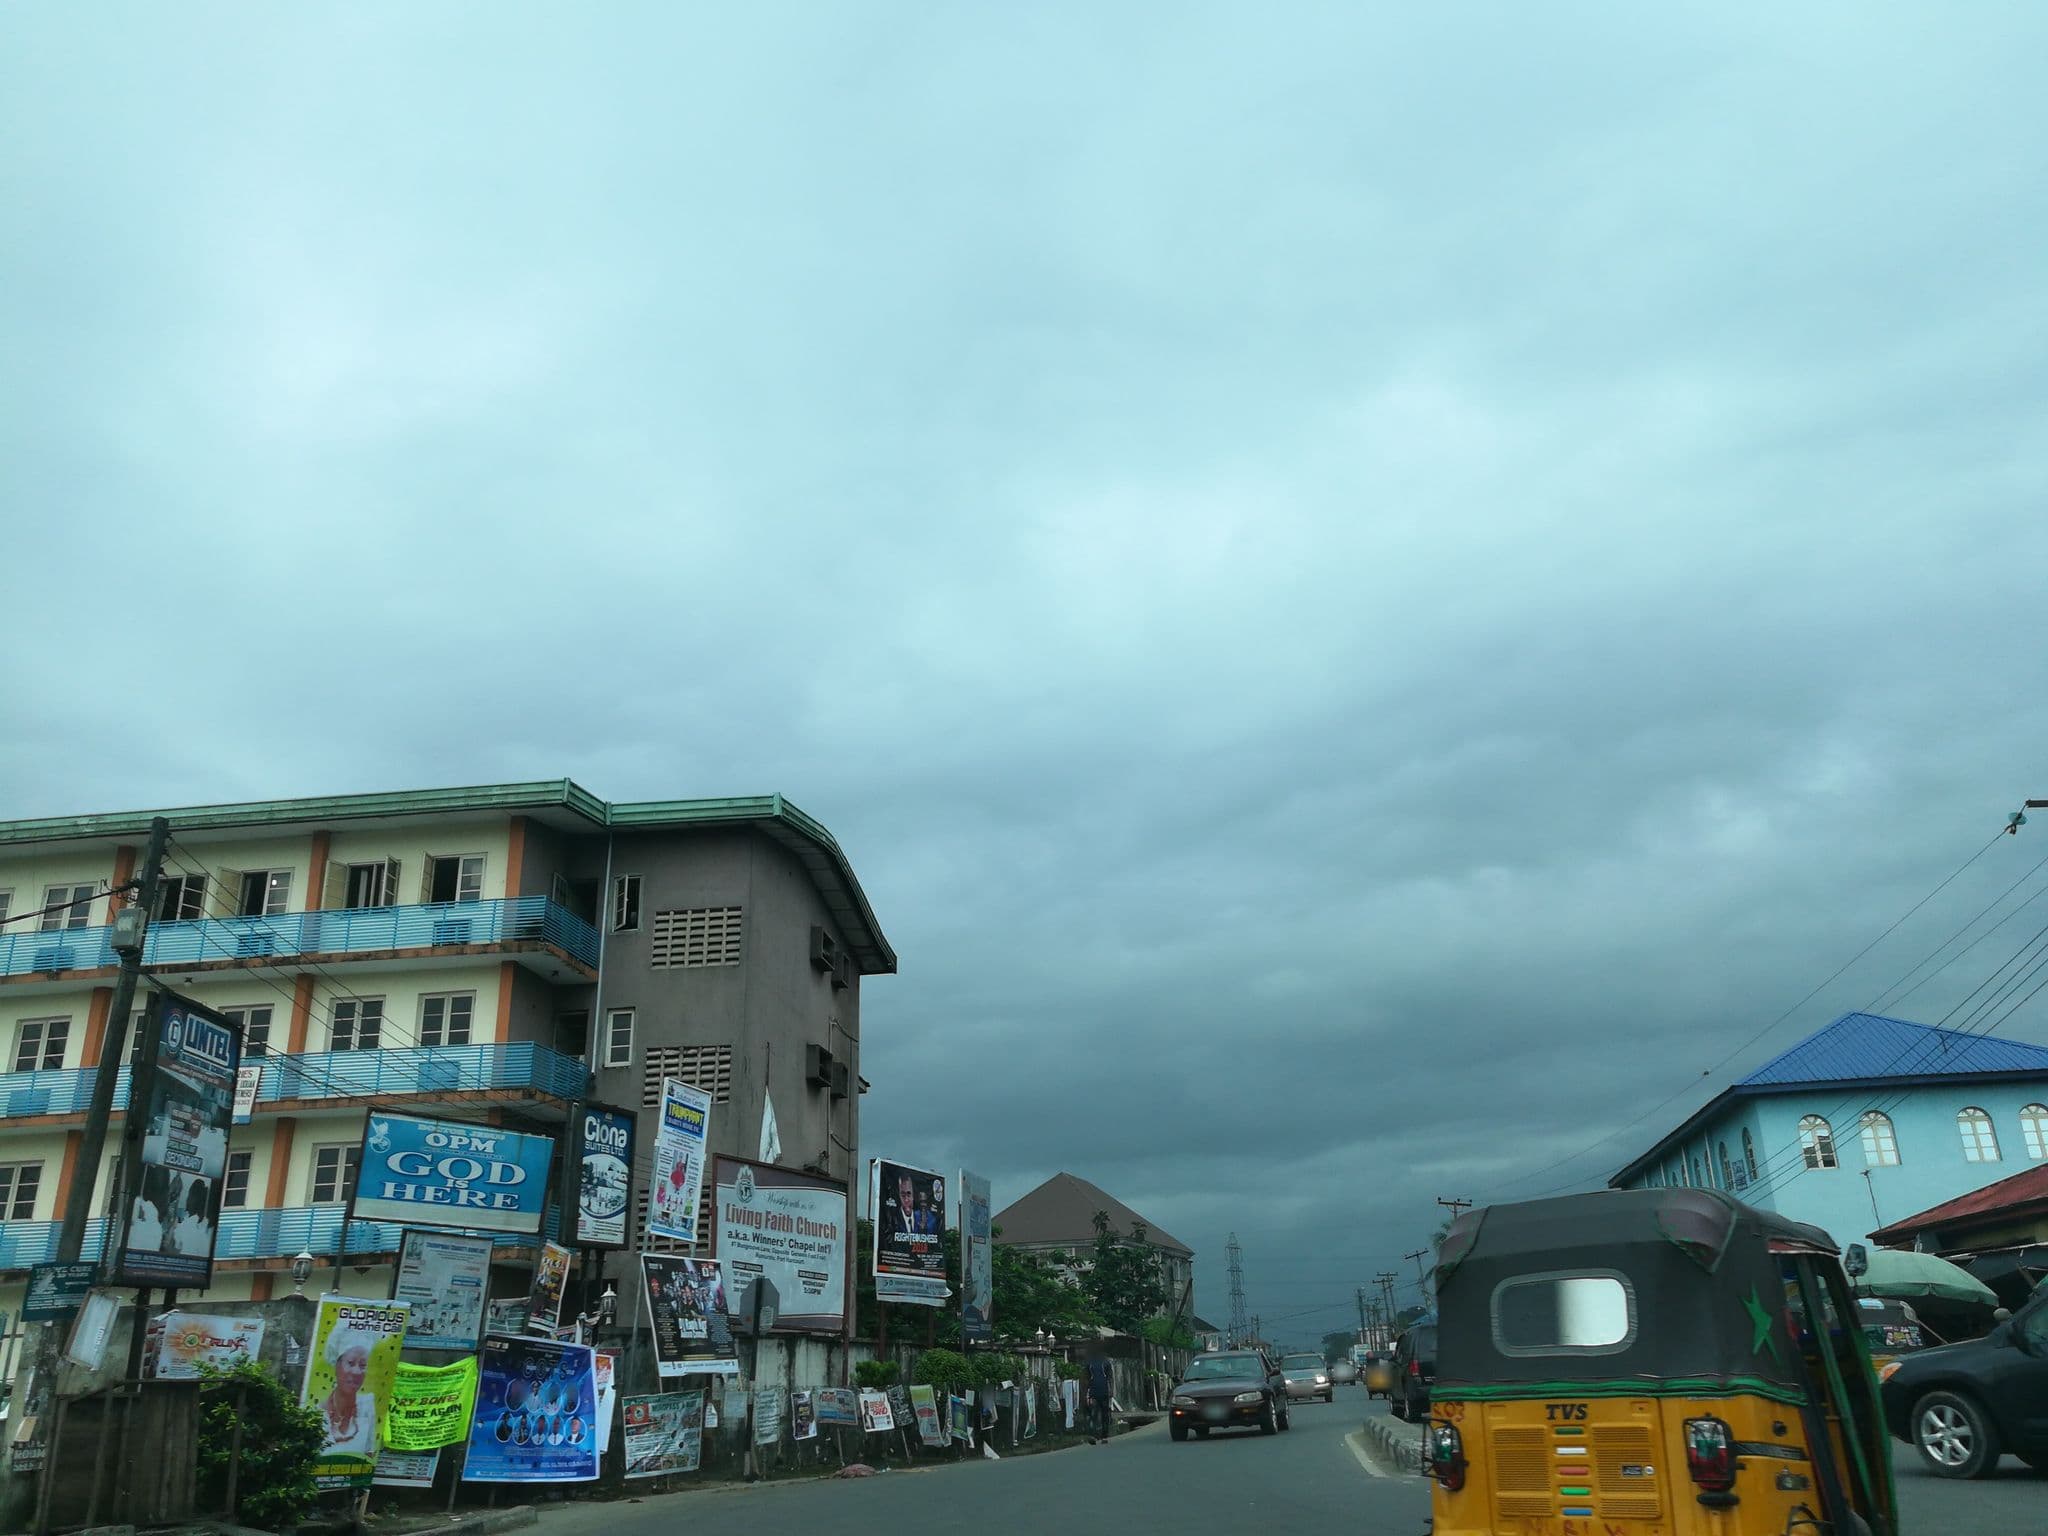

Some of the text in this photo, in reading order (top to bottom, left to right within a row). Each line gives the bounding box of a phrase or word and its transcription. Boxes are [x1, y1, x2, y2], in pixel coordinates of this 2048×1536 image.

[425, 1132, 496, 1153] OPM
[584, 1116, 627, 1148] Ciona
[585, 1140, 610, 1153] SUITES
[387, 1152, 526, 1185] GOD
[381, 1182, 518, 1210] HERE
[725, 1203, 837, 1240] Living Faith Church
[728, 1230, 749, 1242] a.k.a.
[752, 1232, 786, 1247] Winners'
[788, 1238, 816, 1252] Chapel
[340, 1307, 404, 1323] GLORIOUS
[348, 1320, 402, 1333] Home Call
[1546, 1404, 1588, 1421] TVS
